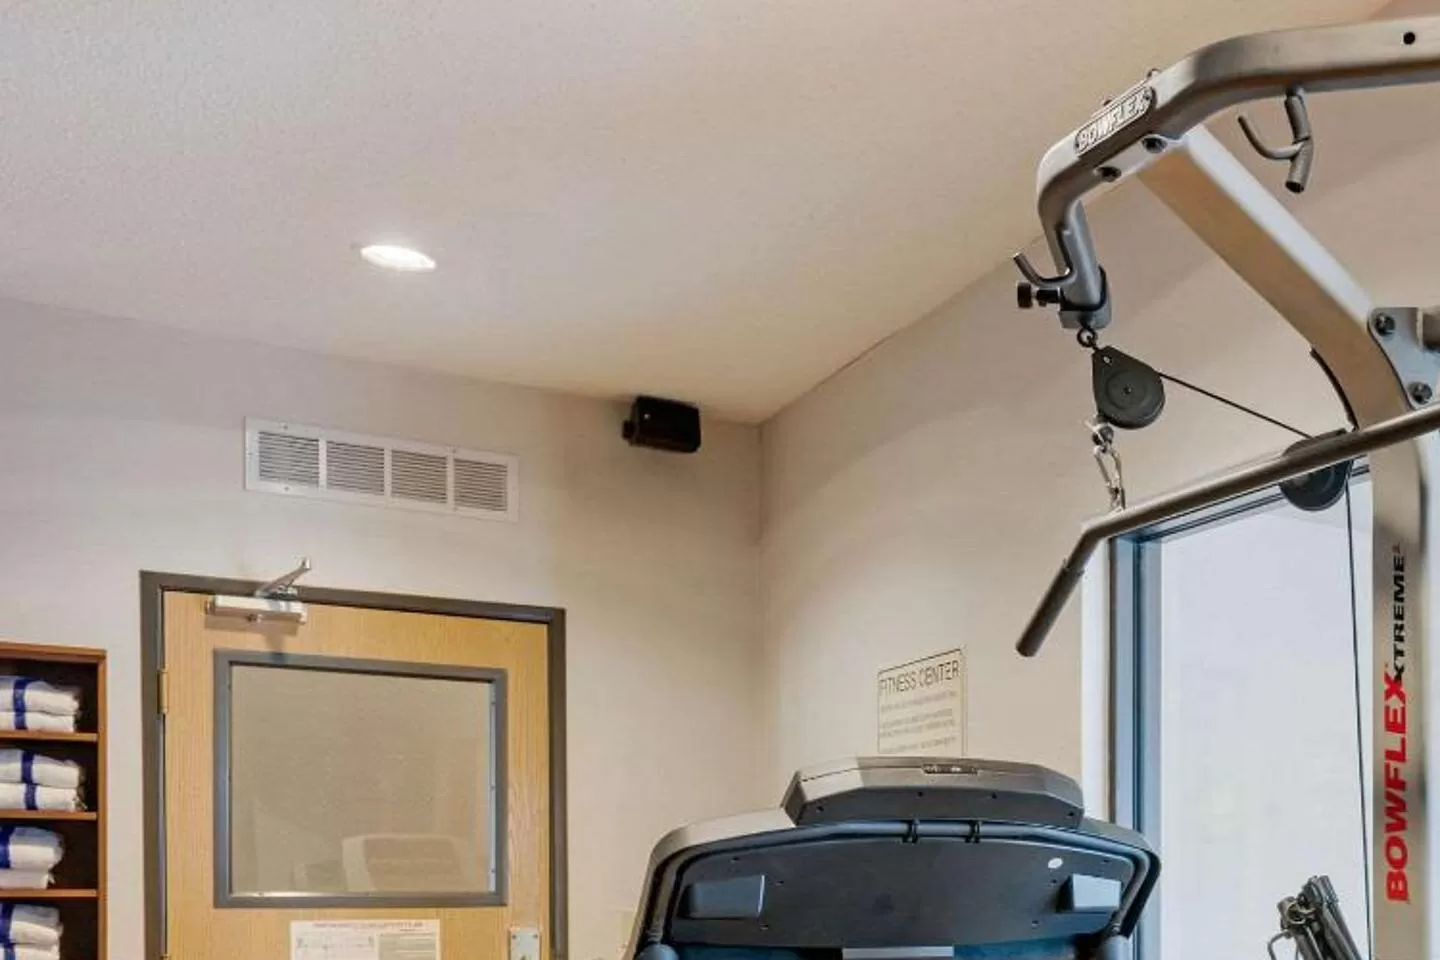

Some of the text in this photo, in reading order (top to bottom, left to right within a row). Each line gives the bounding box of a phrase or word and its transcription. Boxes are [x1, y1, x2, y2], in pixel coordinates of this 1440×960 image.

[879, 659, 960, 695] FITNESS CENTER
[1383, 667, 1409, 904] BOWFLEX
